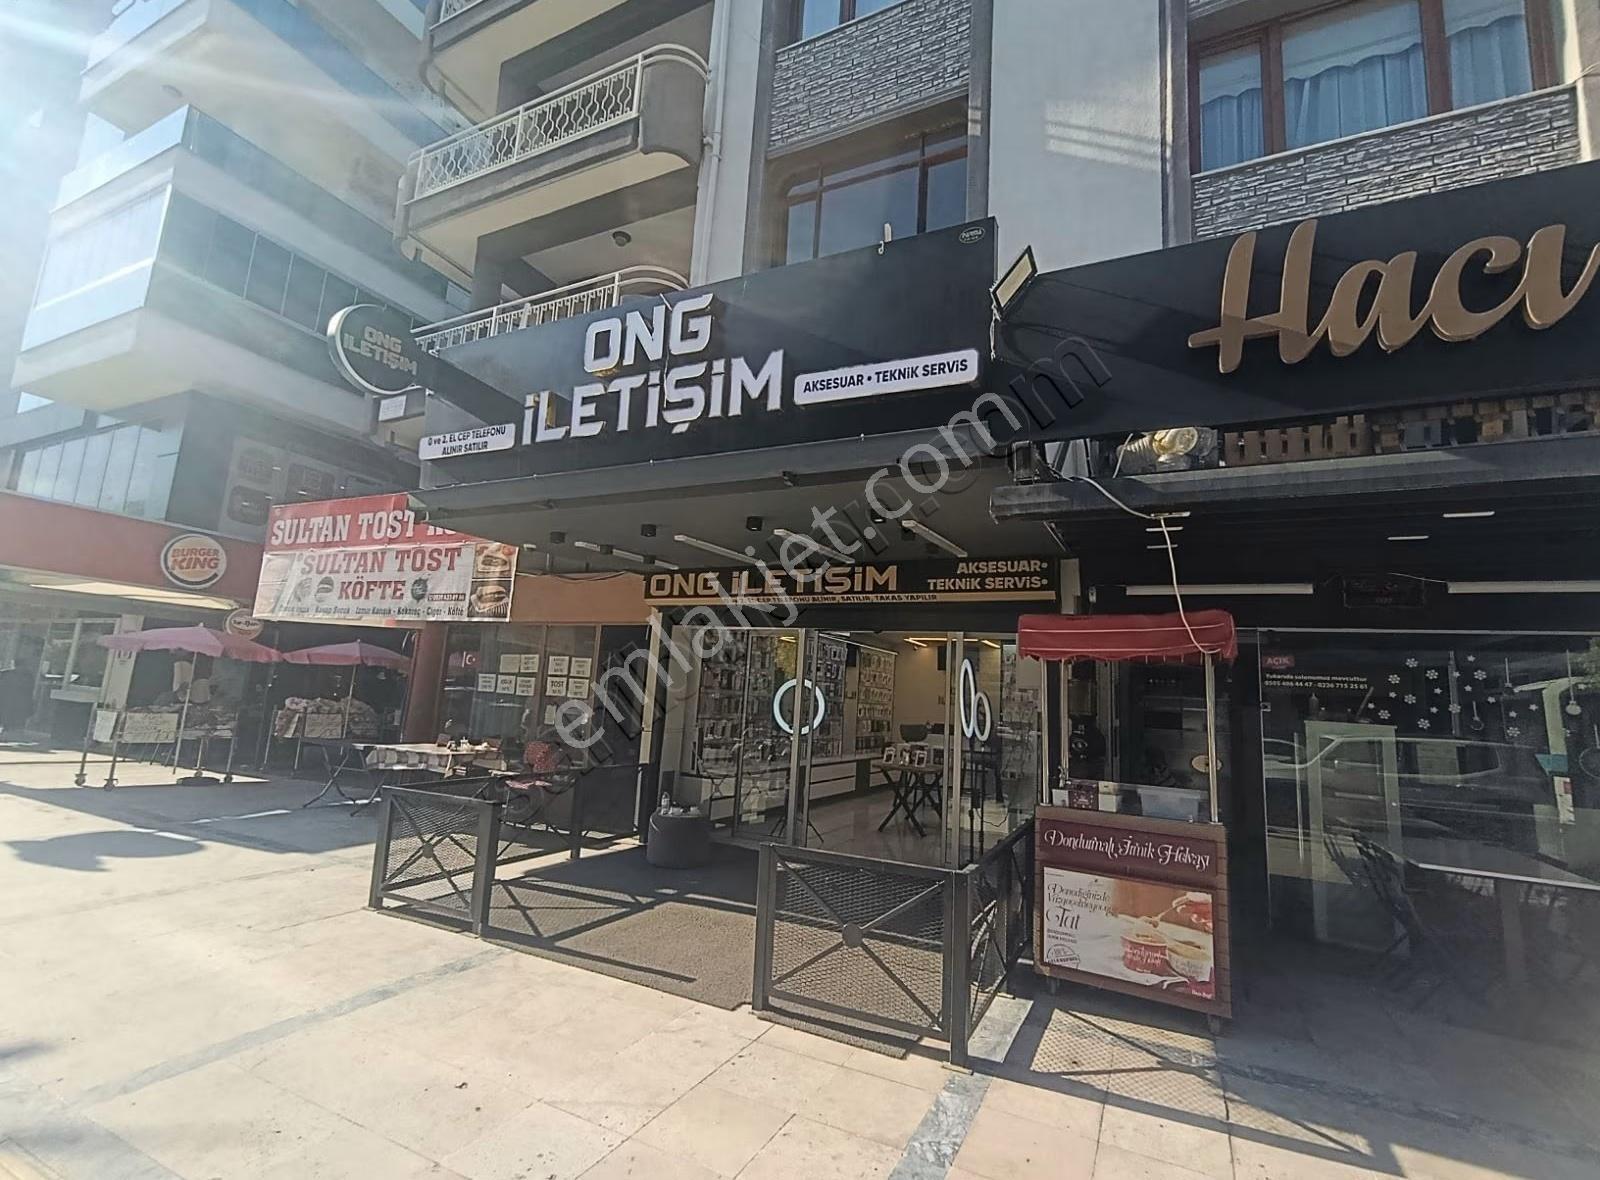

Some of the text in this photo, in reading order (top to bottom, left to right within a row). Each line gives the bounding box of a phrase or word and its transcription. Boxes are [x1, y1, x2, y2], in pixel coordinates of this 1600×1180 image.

[364, 326, 402, 354] ONG
[583, 292, 714, 374] ONG
[803, 374, 864, 394] AKSESUAR
[449, 434, 457, 443] EL
[458, 431, 470, 441] CEP
[471, 426, 506, 440] TELEFONU
[441, 441, 488, 456] ALINIR SATILIR
[271, 514, 352, 546] SULTAN
[171, 547, 220, 558] BURGER
[301, 547, 462, 575] SULTAN TOST
[171, 557, 220, 571] KING
[957, 560, 1041, 574] AKSESUAR
[338, 576, 406, 601] KÖFTE
[650, 571, 719, 597] ONG
